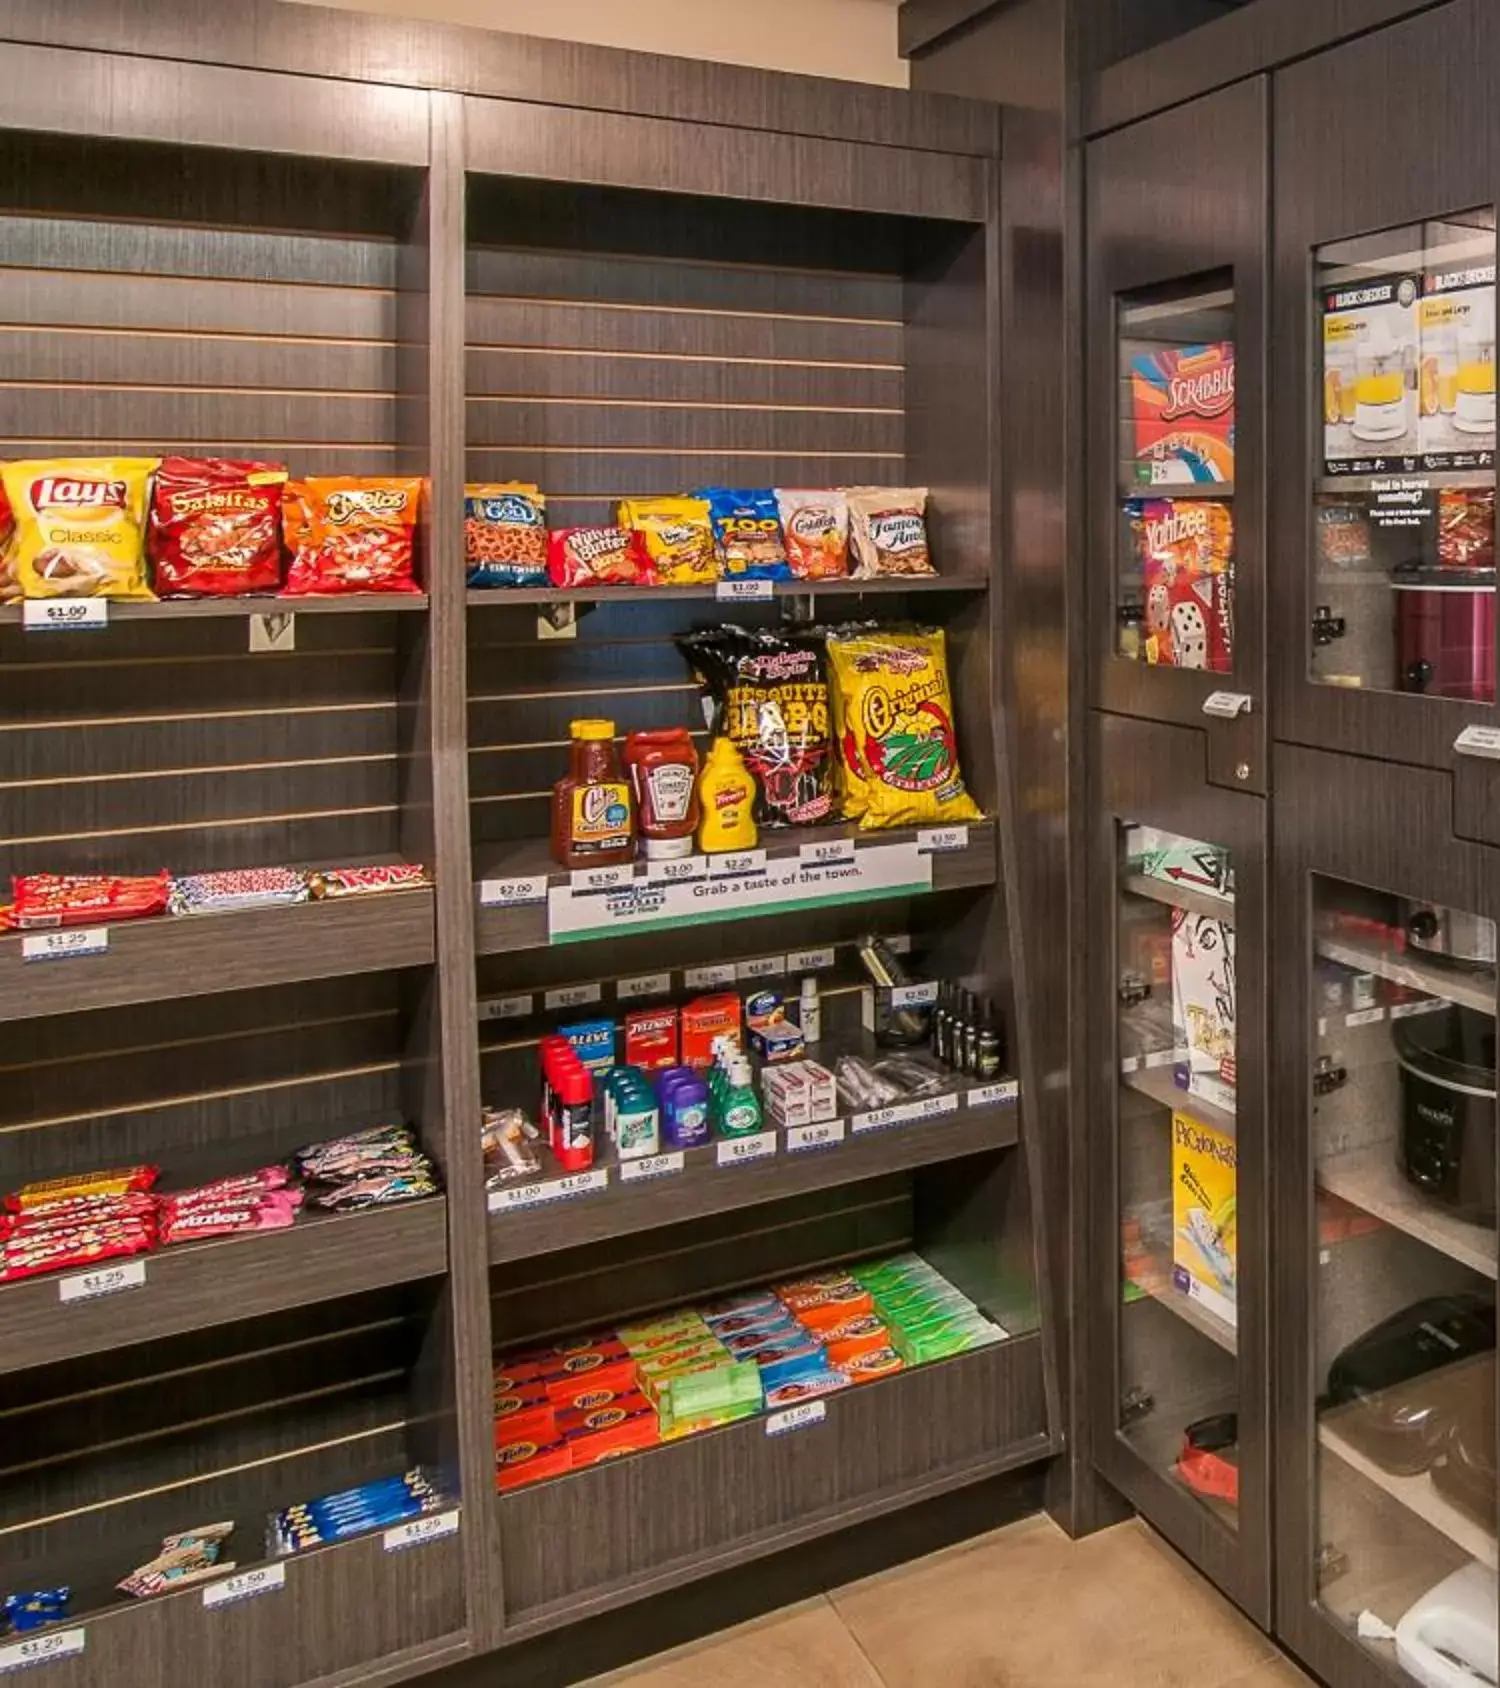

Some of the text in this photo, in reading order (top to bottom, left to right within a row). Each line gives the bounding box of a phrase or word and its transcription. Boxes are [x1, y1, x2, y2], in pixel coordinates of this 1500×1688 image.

[717, 517, 779, 533] ZOO
[1146, 509, 1208, 548] Yahtzee
[49, 529, 123, 545] Classic
[47, 606, 87, 618] $1.00
[729, 683, 828, 704] MESQUITE
[692, 867, 863, 897] Grab a taste of the town.
[47, 933, 88, 947] $1.25
